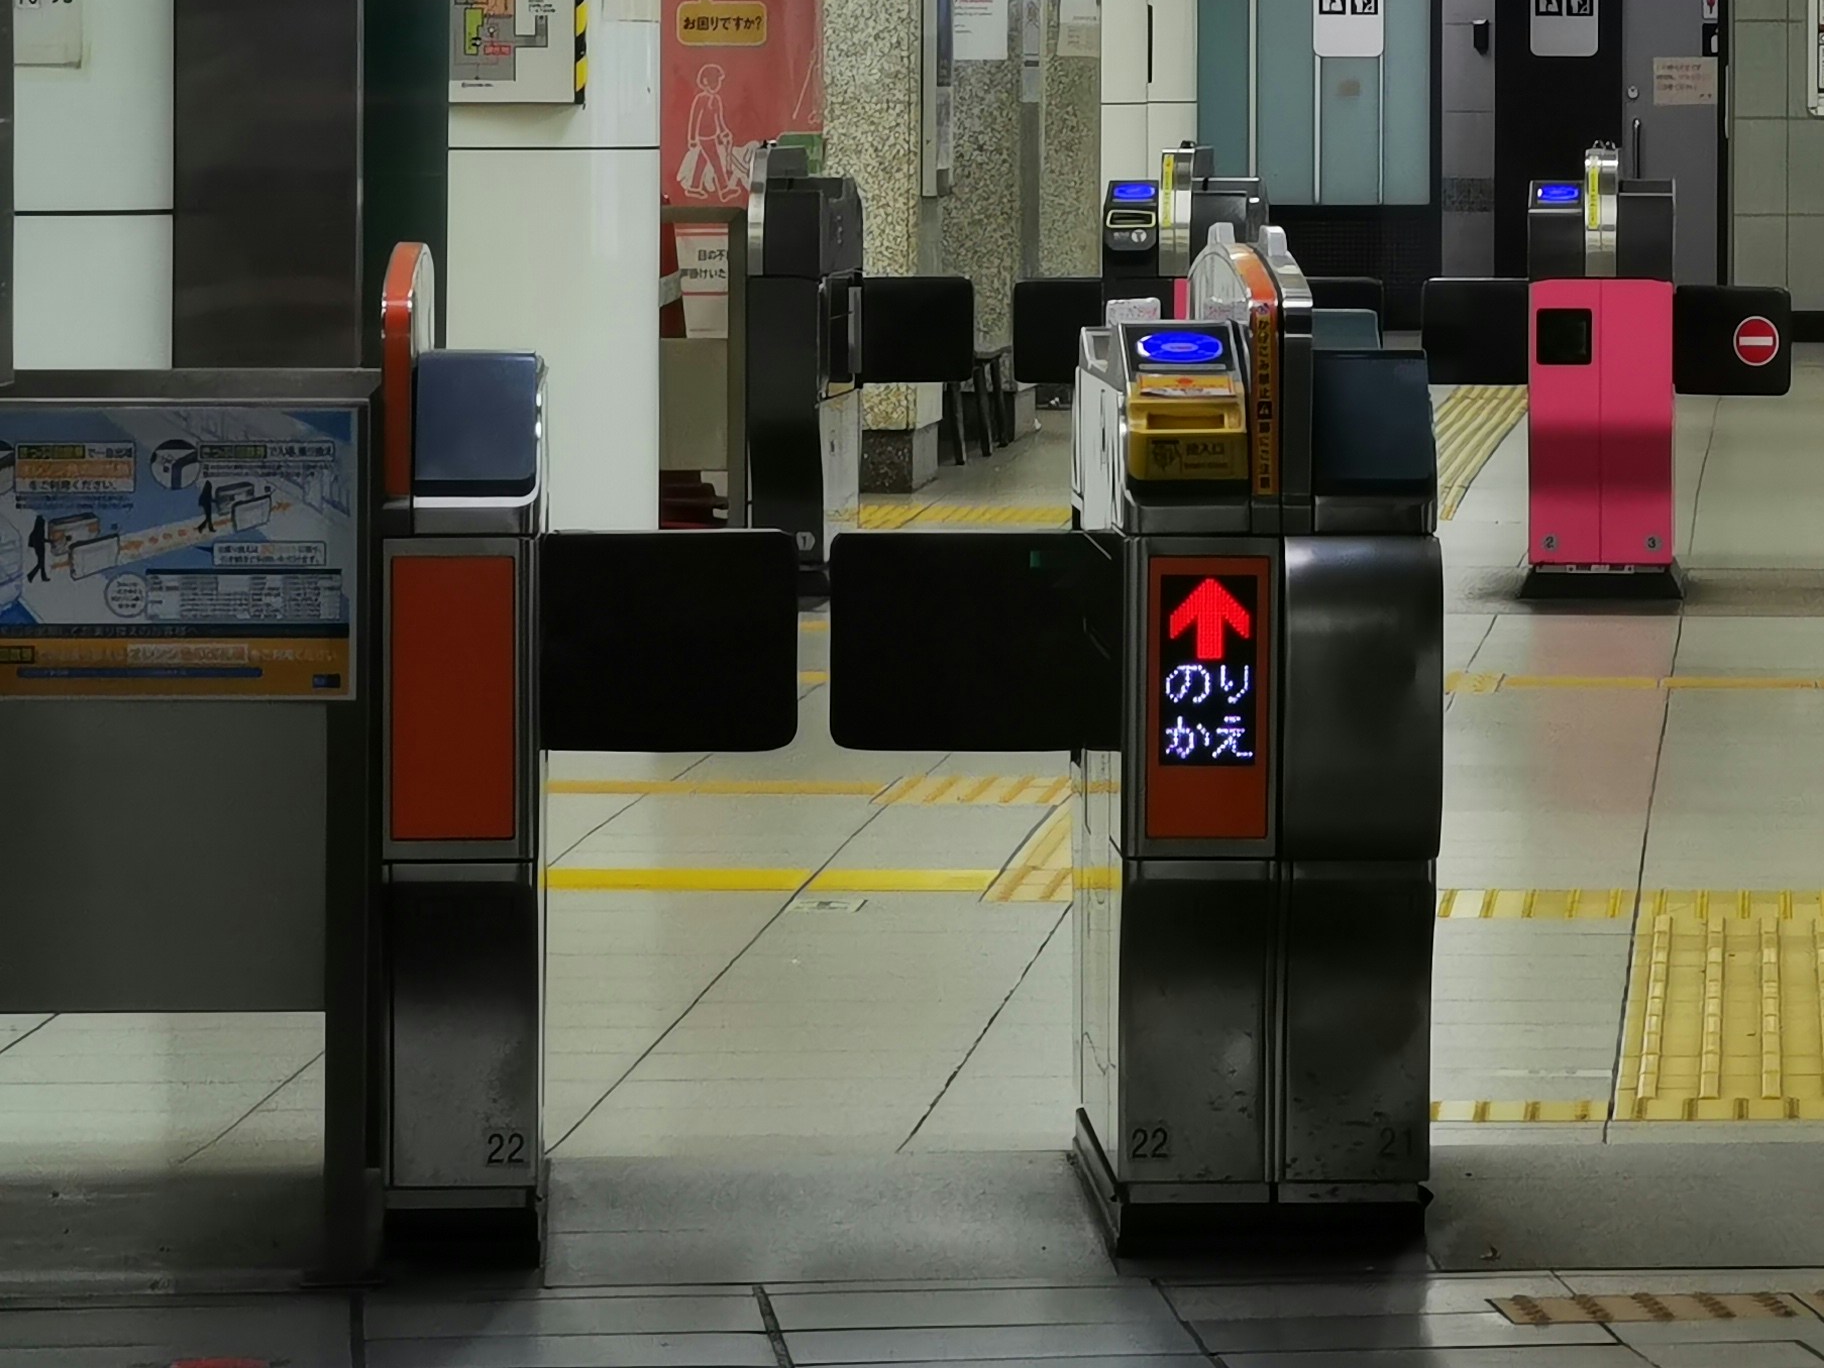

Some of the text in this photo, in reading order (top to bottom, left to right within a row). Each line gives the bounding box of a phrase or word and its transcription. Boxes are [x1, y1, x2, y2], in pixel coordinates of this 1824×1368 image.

[1166, 664, 1249, 704] のり
[1165, 715, 1254, 758] かえ
[487, 1133, 523, 1164] 22
[1132, 1128, 1168, 1158] 22
